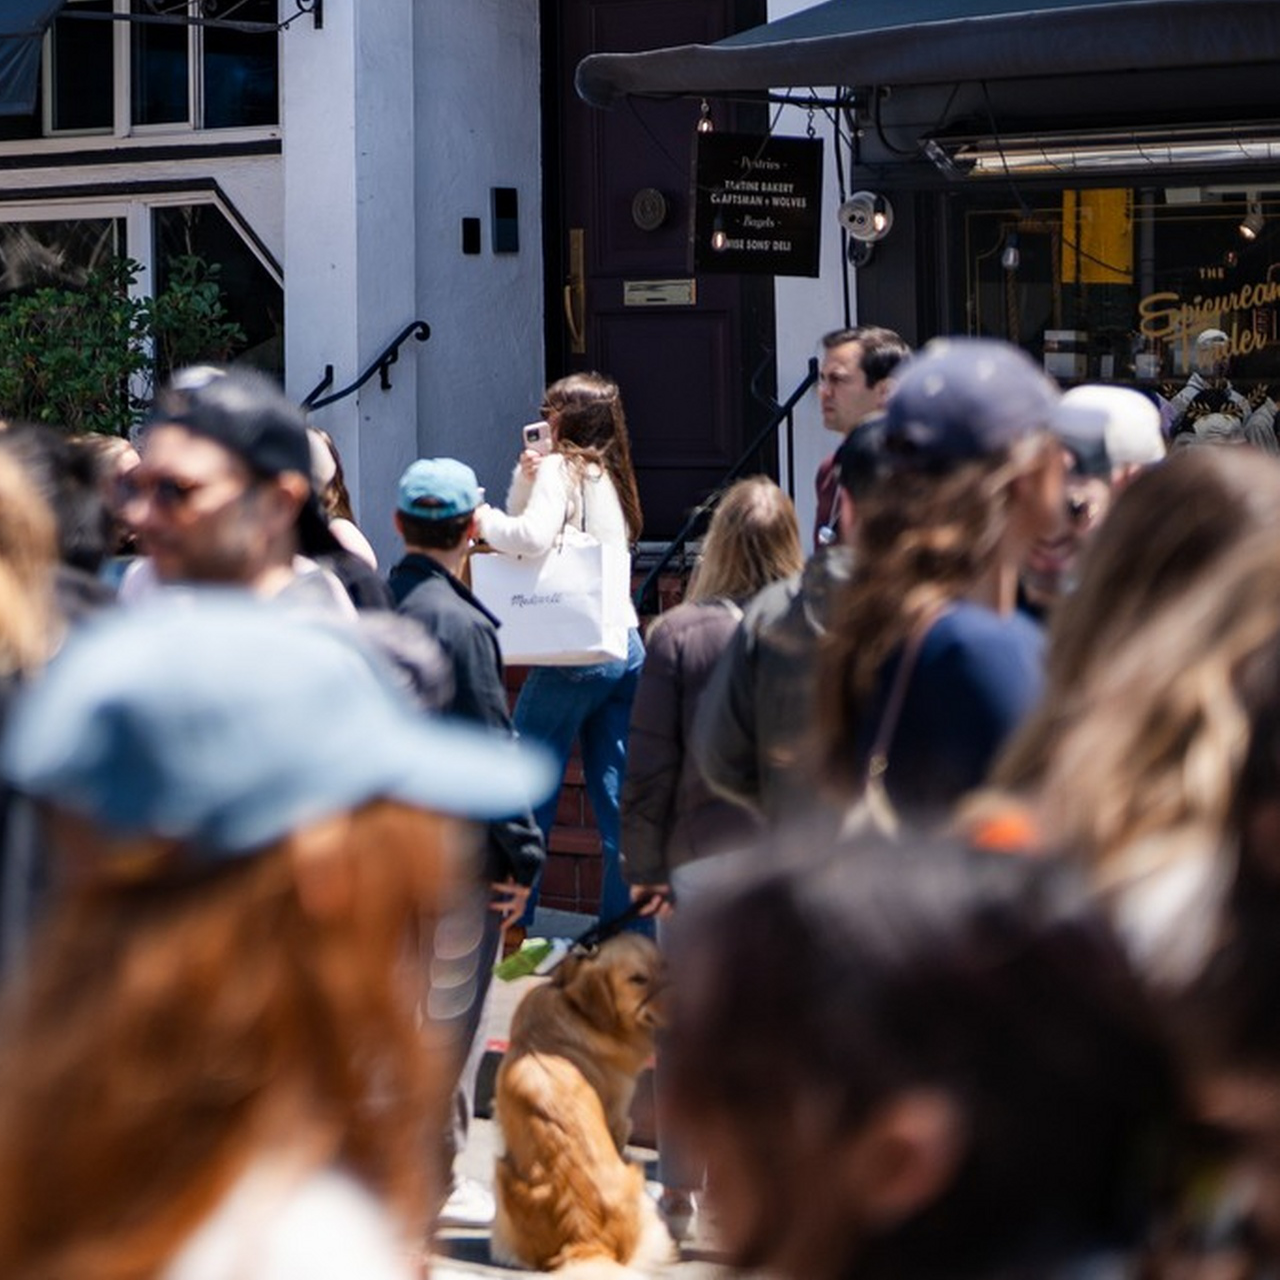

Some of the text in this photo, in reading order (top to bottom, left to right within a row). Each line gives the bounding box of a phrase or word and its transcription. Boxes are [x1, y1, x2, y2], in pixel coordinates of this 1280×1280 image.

[761, 181, 794, 194] BAKERY
[772, 197, 807, 208] WOLVES
[772, 240, 791, 252] DELI
[1199, 267, 1225, 279] THE
